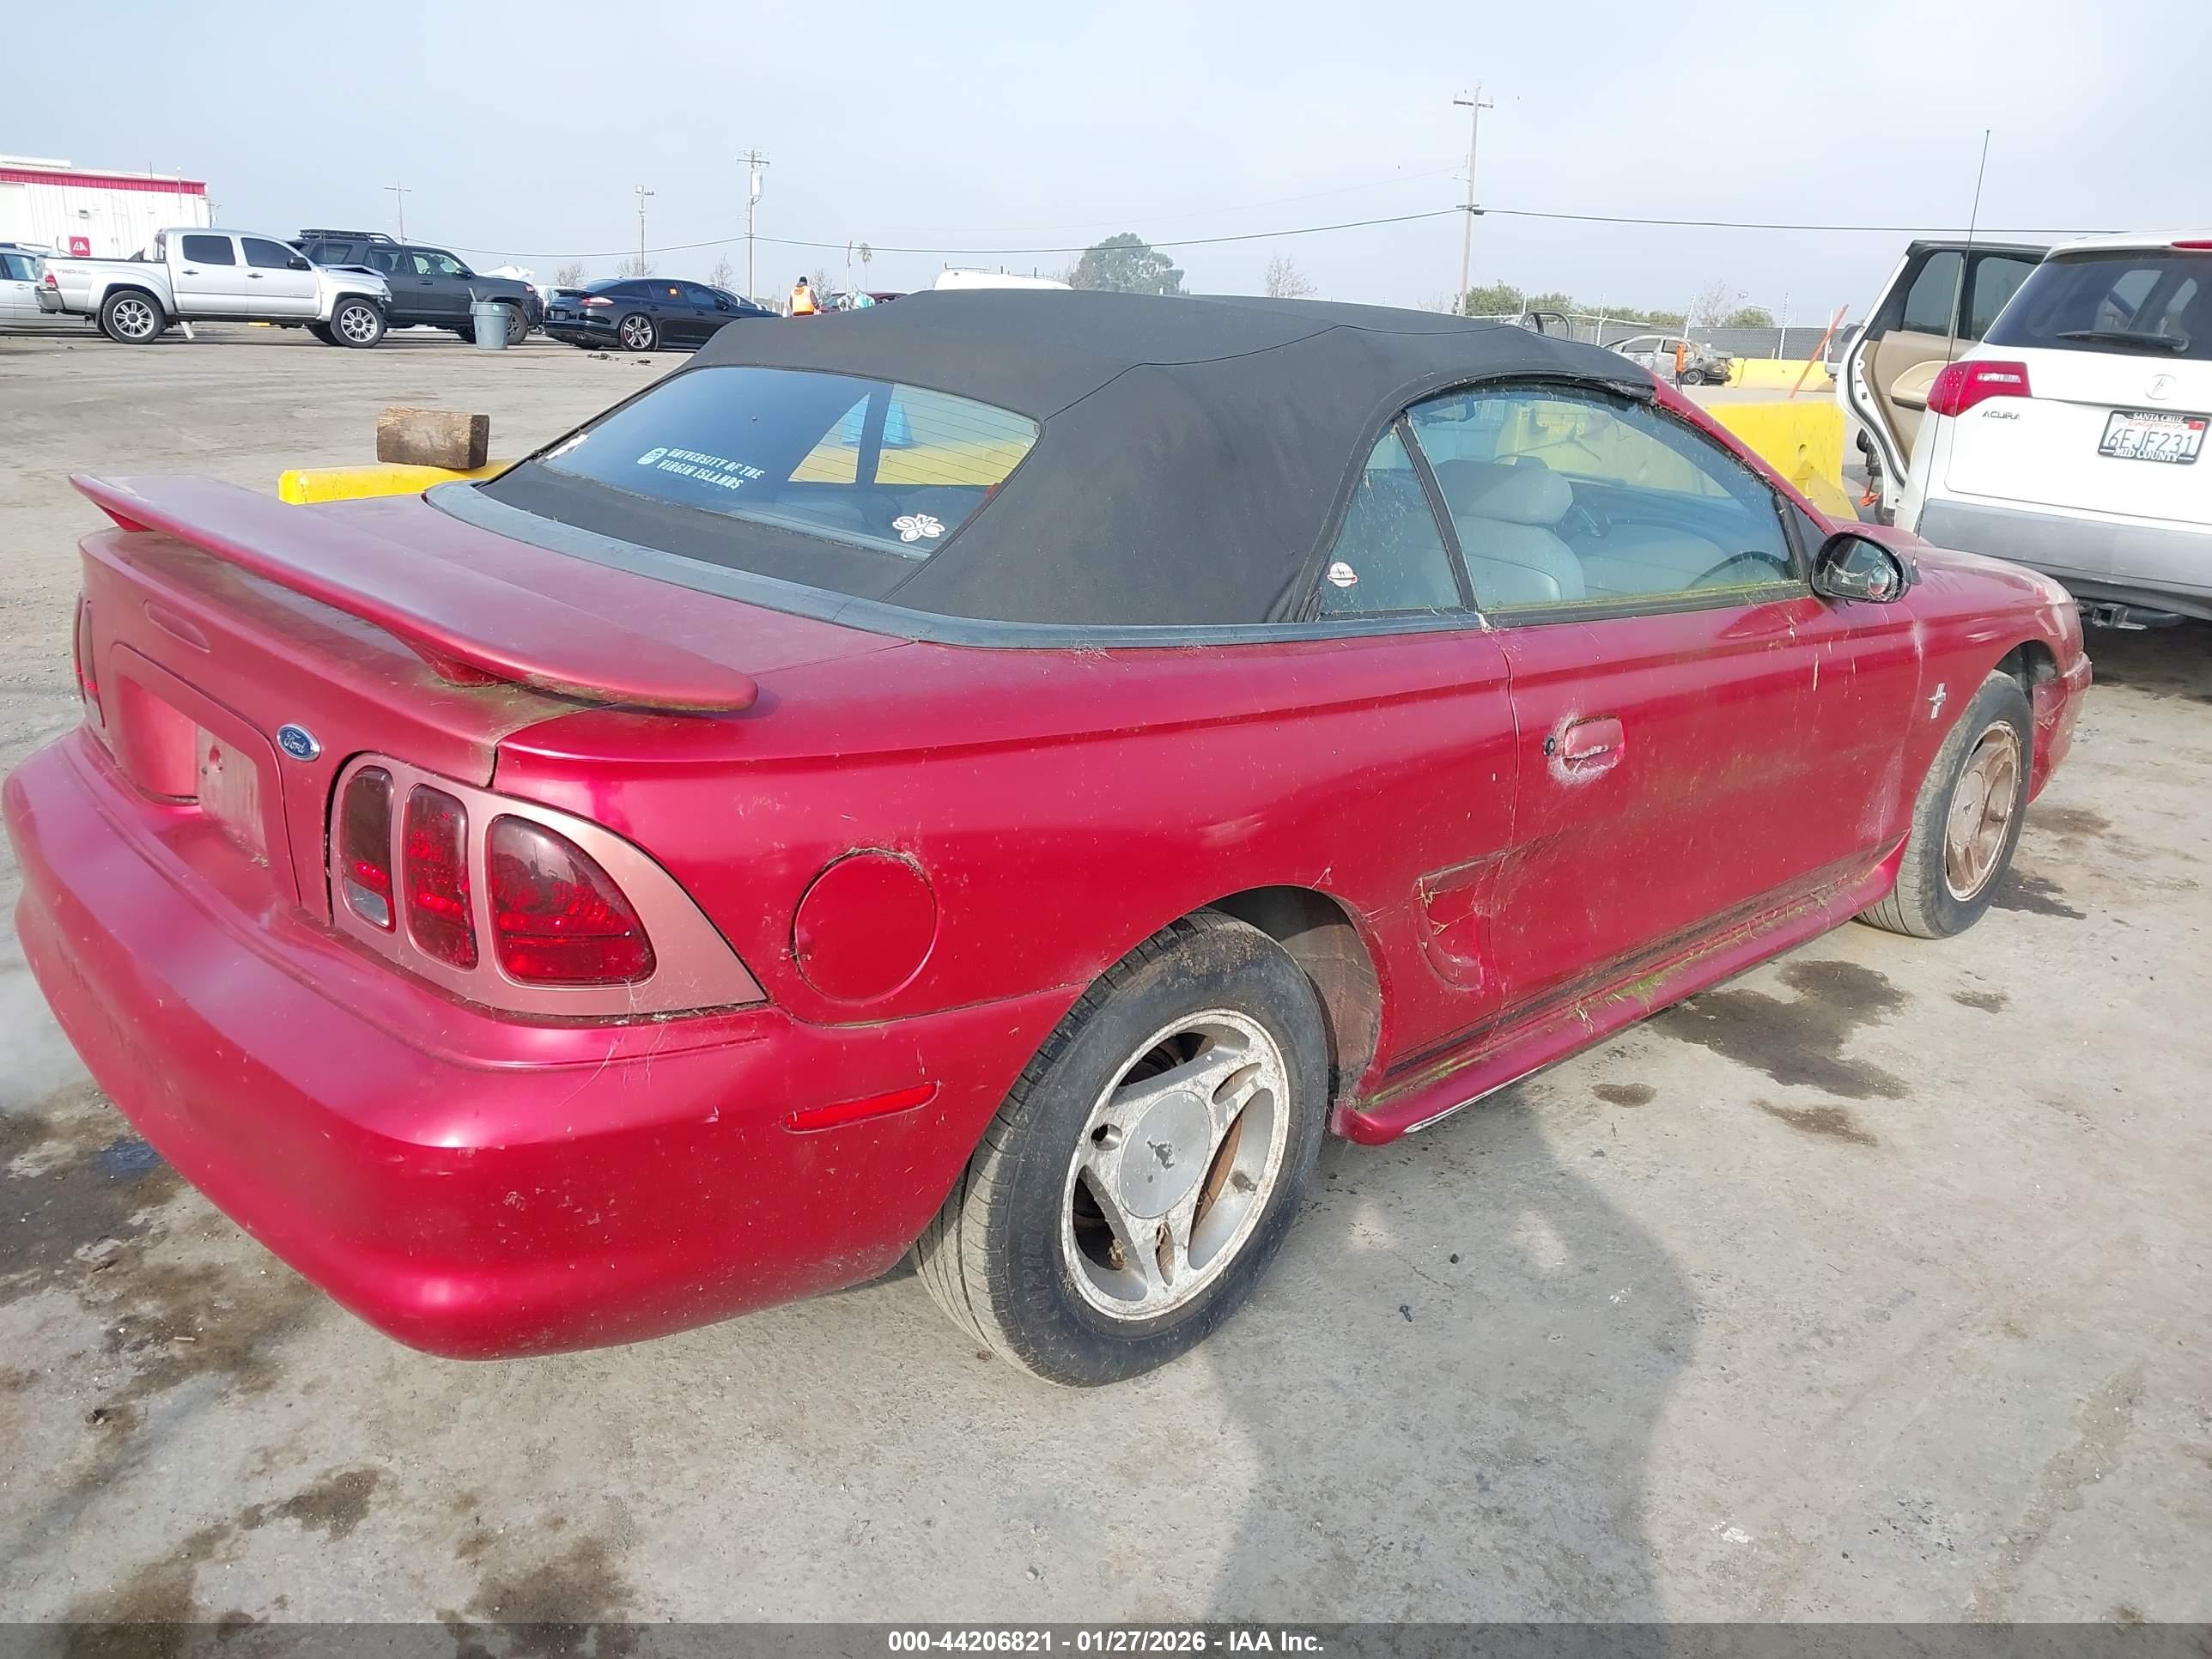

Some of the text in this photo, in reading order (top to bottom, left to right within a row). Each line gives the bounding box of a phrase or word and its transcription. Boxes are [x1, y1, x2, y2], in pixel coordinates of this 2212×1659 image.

[1982, 410, 2020, 420] ACURA
[2133, 412, 2185, 423] SANTA CRUZ
[2108, 428, 2194, 455] 6EJF231
[667, 448, 765, 479] UNIVERSITY OF THE
[2113, 447, 2136, 458] MID
[2136, 448, 2181, 462] COUNTY
[656, 459, 744, 490] VIRGIN ISLANDS
[283, 730, 307, 754] Ford
